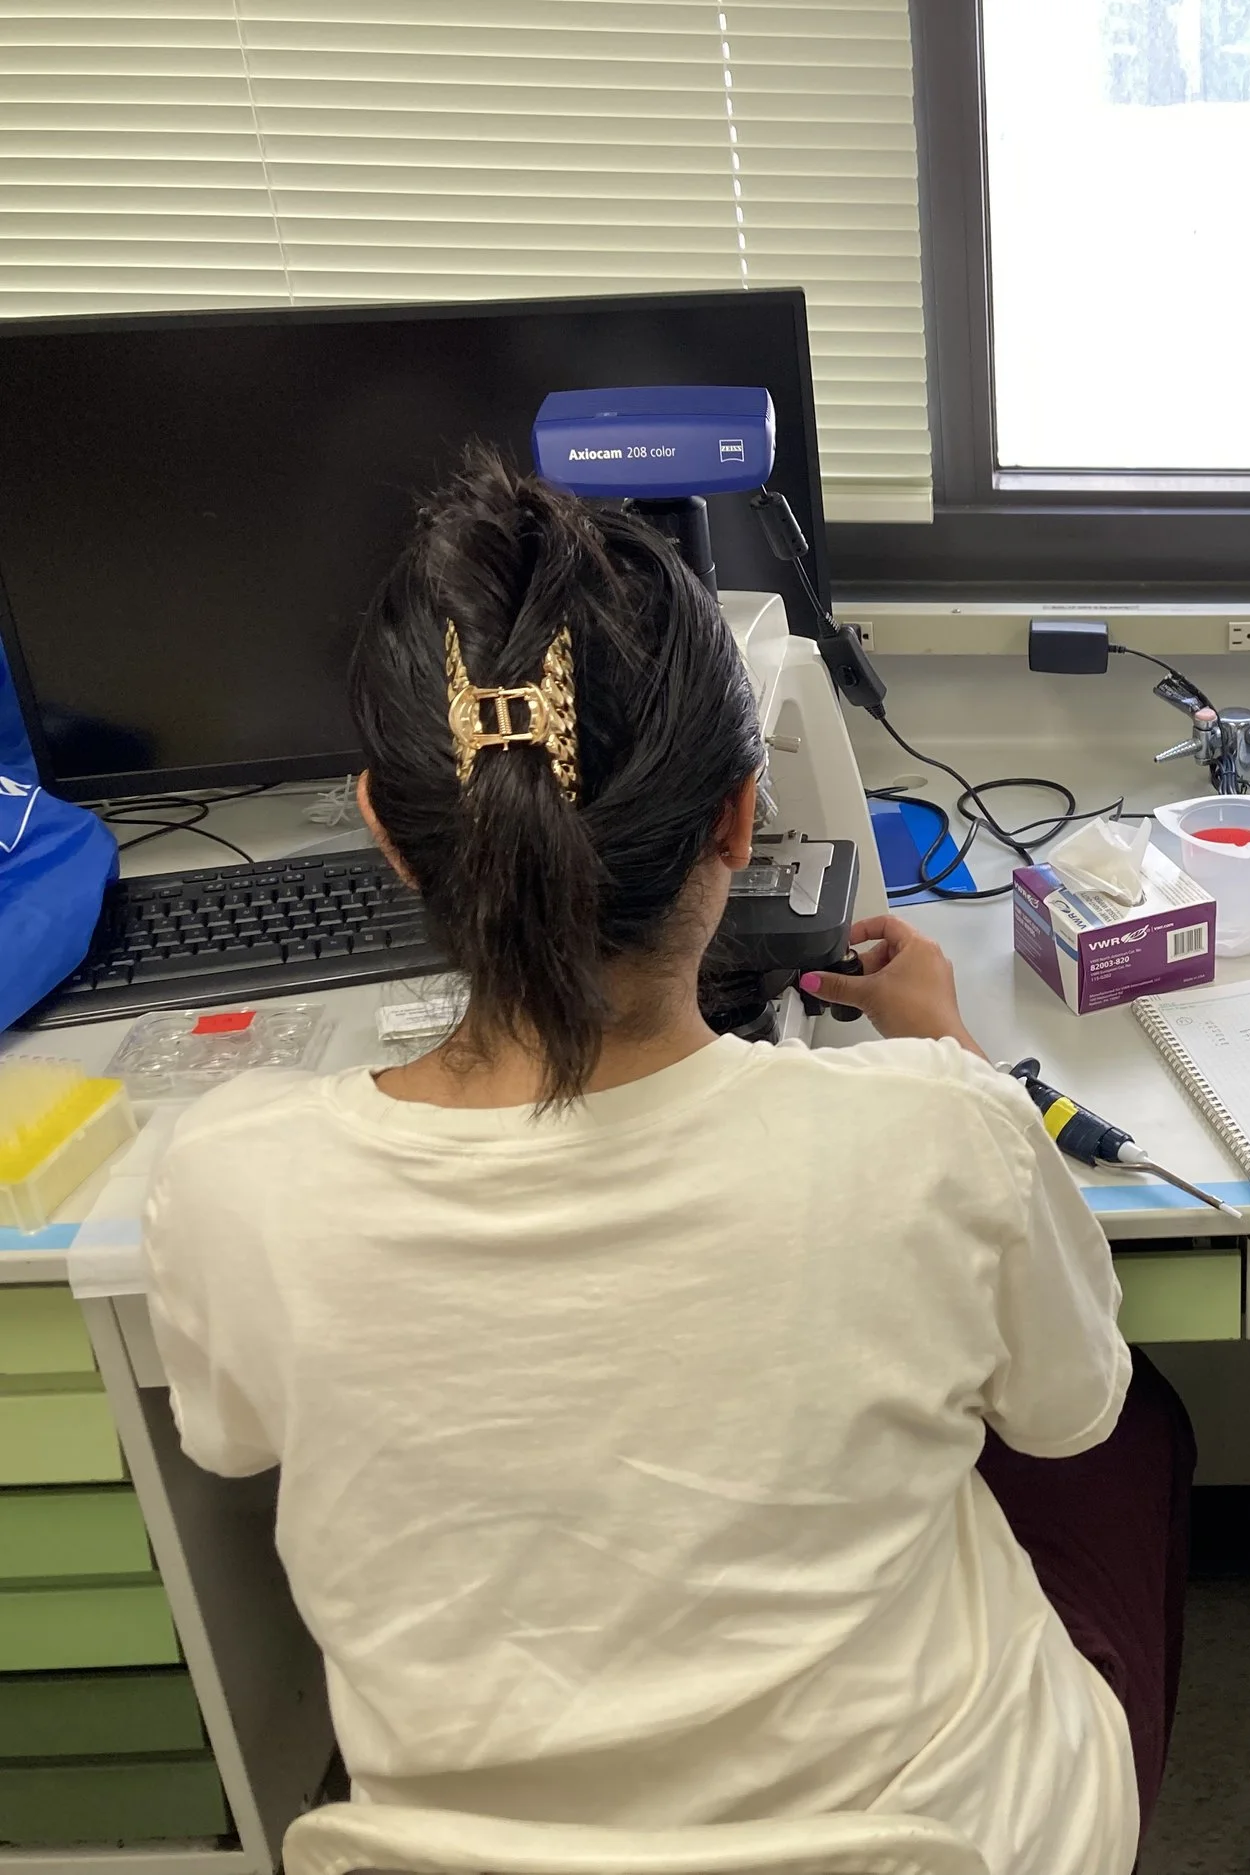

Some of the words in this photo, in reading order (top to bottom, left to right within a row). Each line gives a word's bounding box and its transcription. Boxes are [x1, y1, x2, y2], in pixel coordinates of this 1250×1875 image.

[569, 448, 622, 461] Axiocam
[627, 446, 648, 459] 208
[650, 445, 676, 458] color
[1067, 912, 1087, 929] VWR
[1088, 937, 1120, 951] VWR
[1090, 956, 1130, 971] 82003-820
